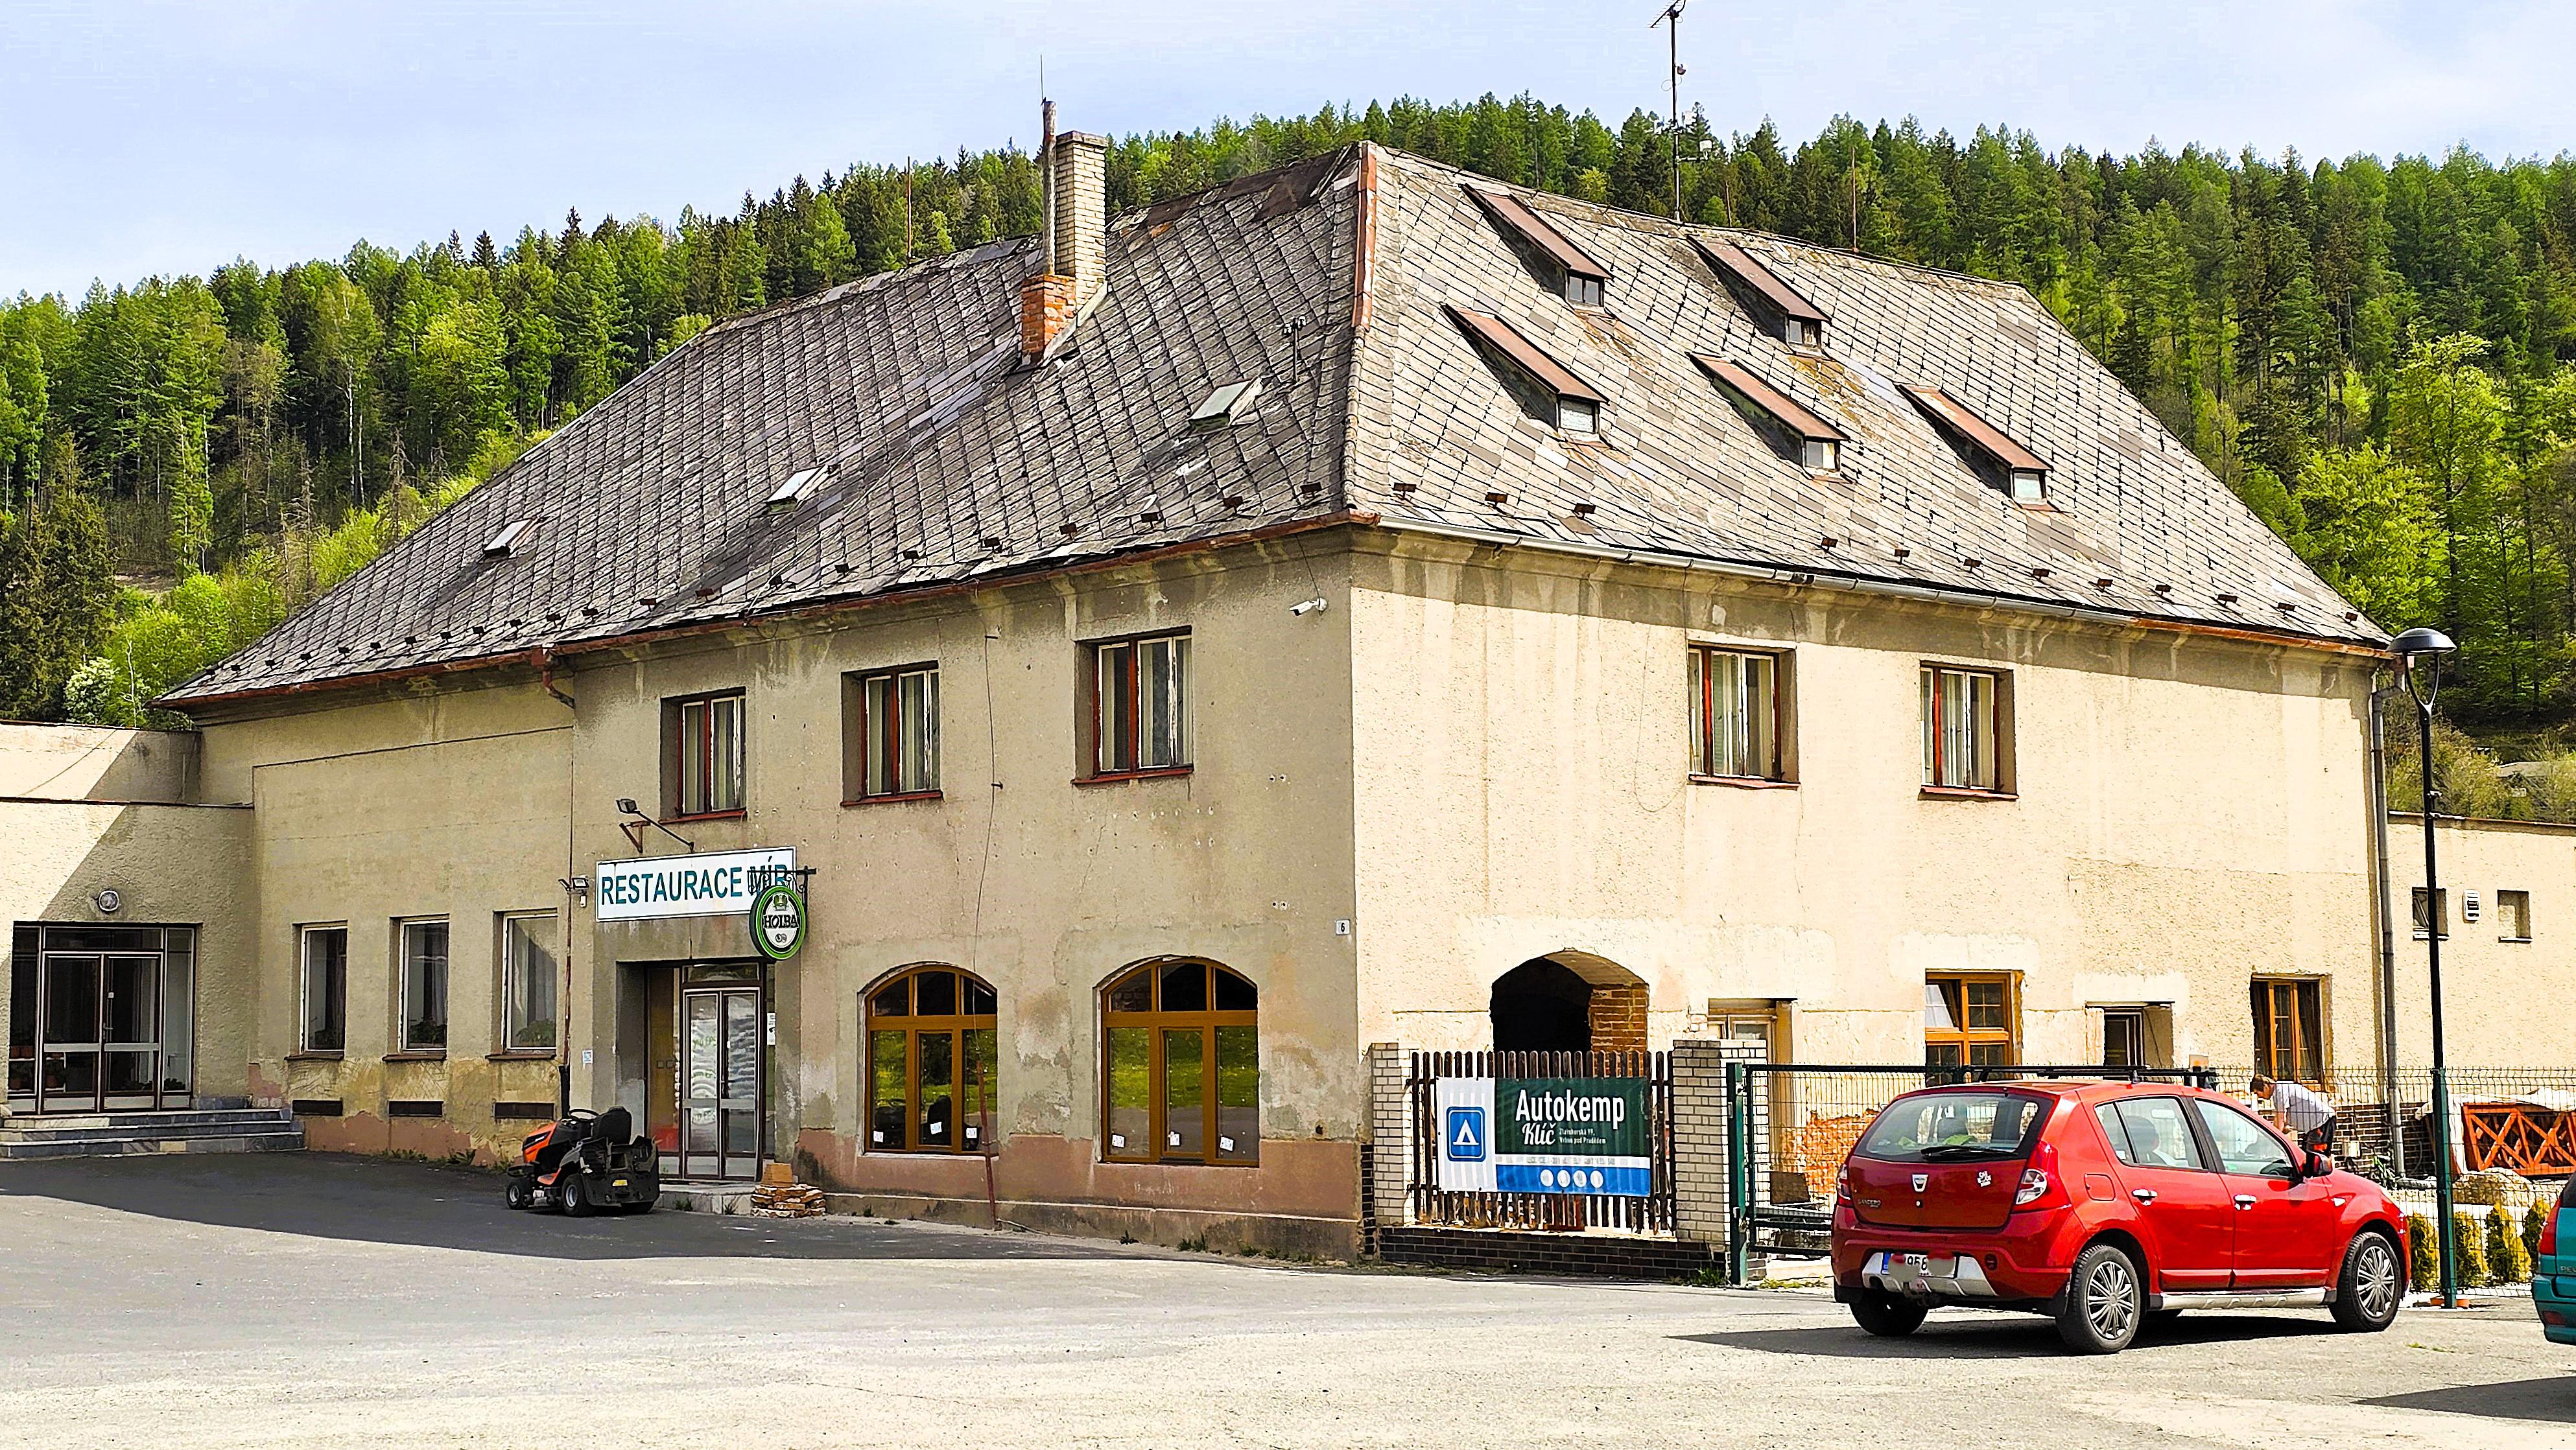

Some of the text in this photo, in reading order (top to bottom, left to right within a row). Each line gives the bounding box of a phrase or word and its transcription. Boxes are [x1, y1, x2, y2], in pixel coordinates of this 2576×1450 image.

[602, 867, 743, 905] RESTAURACE
[763, 915, 799, 929] HOLBA
[1341, 922, 1345, 932] 6
[1515, 1089, 1625, 1130] Autokemp
[1522, 1122, 1556, 1145] Klíč
